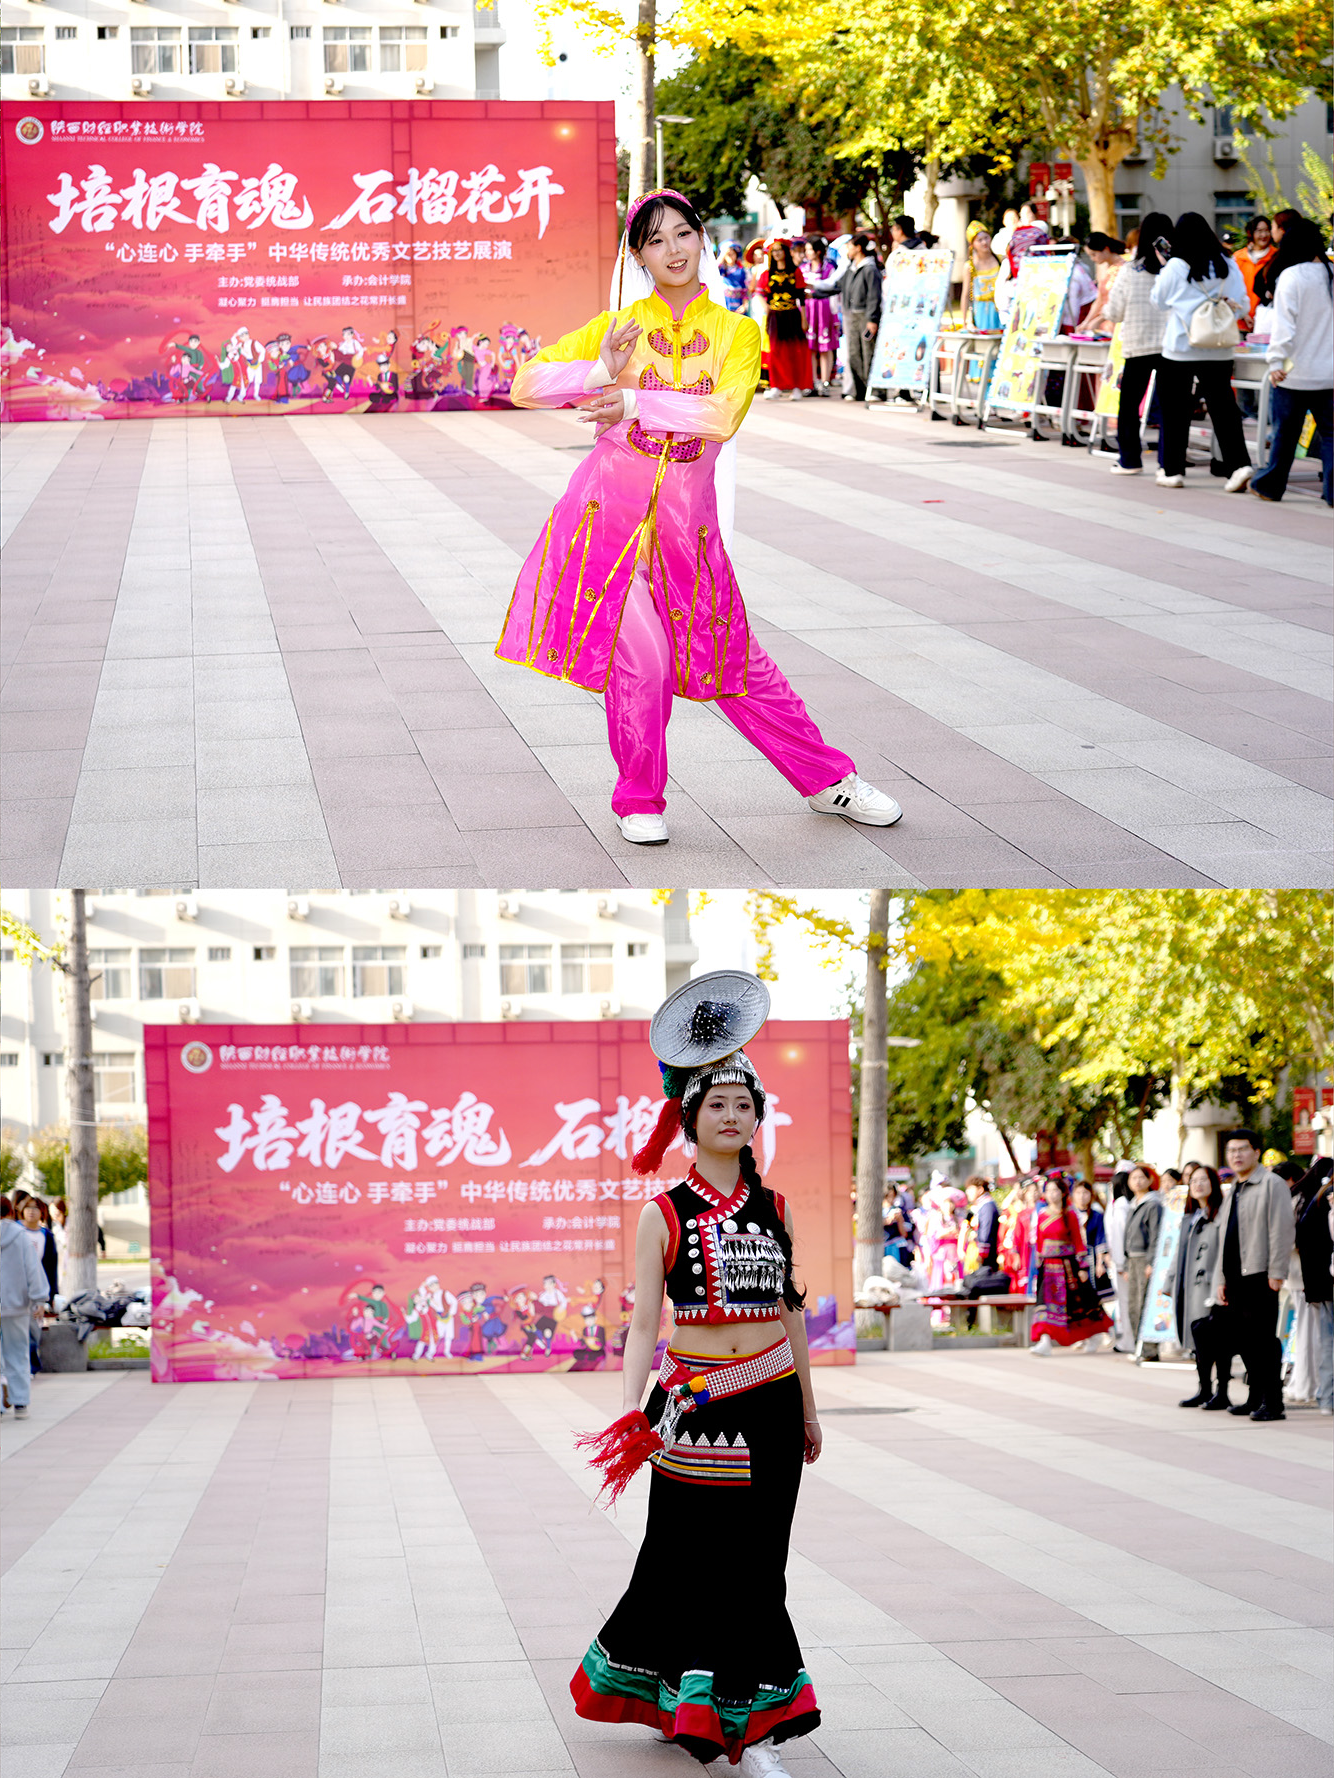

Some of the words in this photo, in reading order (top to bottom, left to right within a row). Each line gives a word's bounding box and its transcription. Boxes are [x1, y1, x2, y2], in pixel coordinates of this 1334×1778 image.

[47, 163, 314, 234] 培根育魂
[320, 164, 565, 240] 石榴花开
[269, 240, 512, 262] 中华传统优秀文艺技艺展演
[215, 1092, 512, 1172] 培根育魂
